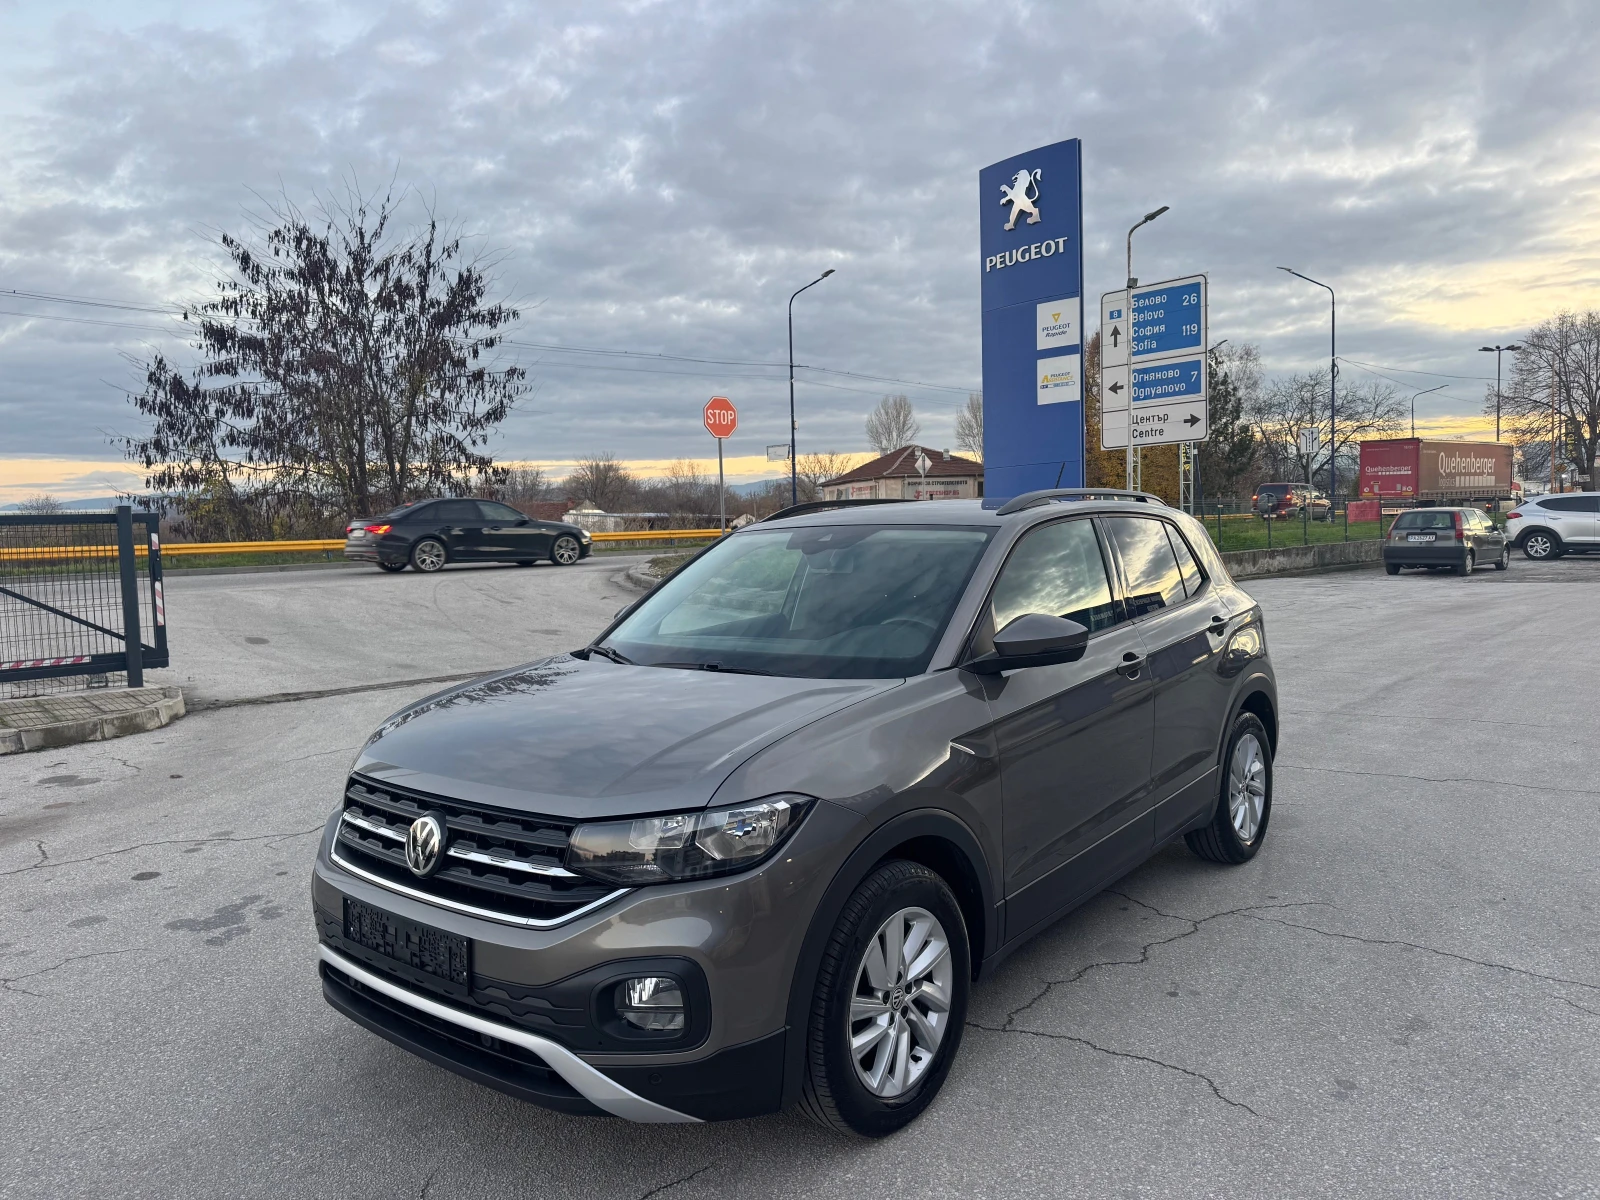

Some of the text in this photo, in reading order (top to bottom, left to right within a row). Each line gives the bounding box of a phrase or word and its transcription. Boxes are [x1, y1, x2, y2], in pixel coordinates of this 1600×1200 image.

[986, 236, 1068, 273] PEUGEOT
[1132, 293, 1198, 309] Белово 26
[1132, 309, 1165, 323] Belovo
[1042, 322, 1071, 332] PEUGEOT
[1132, 323, 1198, 337] София 119
[1132, 339, 1157, 352] Sofia
[1132, 369, 1198, 383] Огняново 7
[1132, 383, 1186, 399] Ognyanovo
[707, 409, 735, 425] STOP
[1132, 413, 1169, 426] Център
[1132, 427, 1165, 439] Centre
[1365, 465, 1412, 473] Quehenberger
[1438, 451, 1496, 478] Quehenberger
